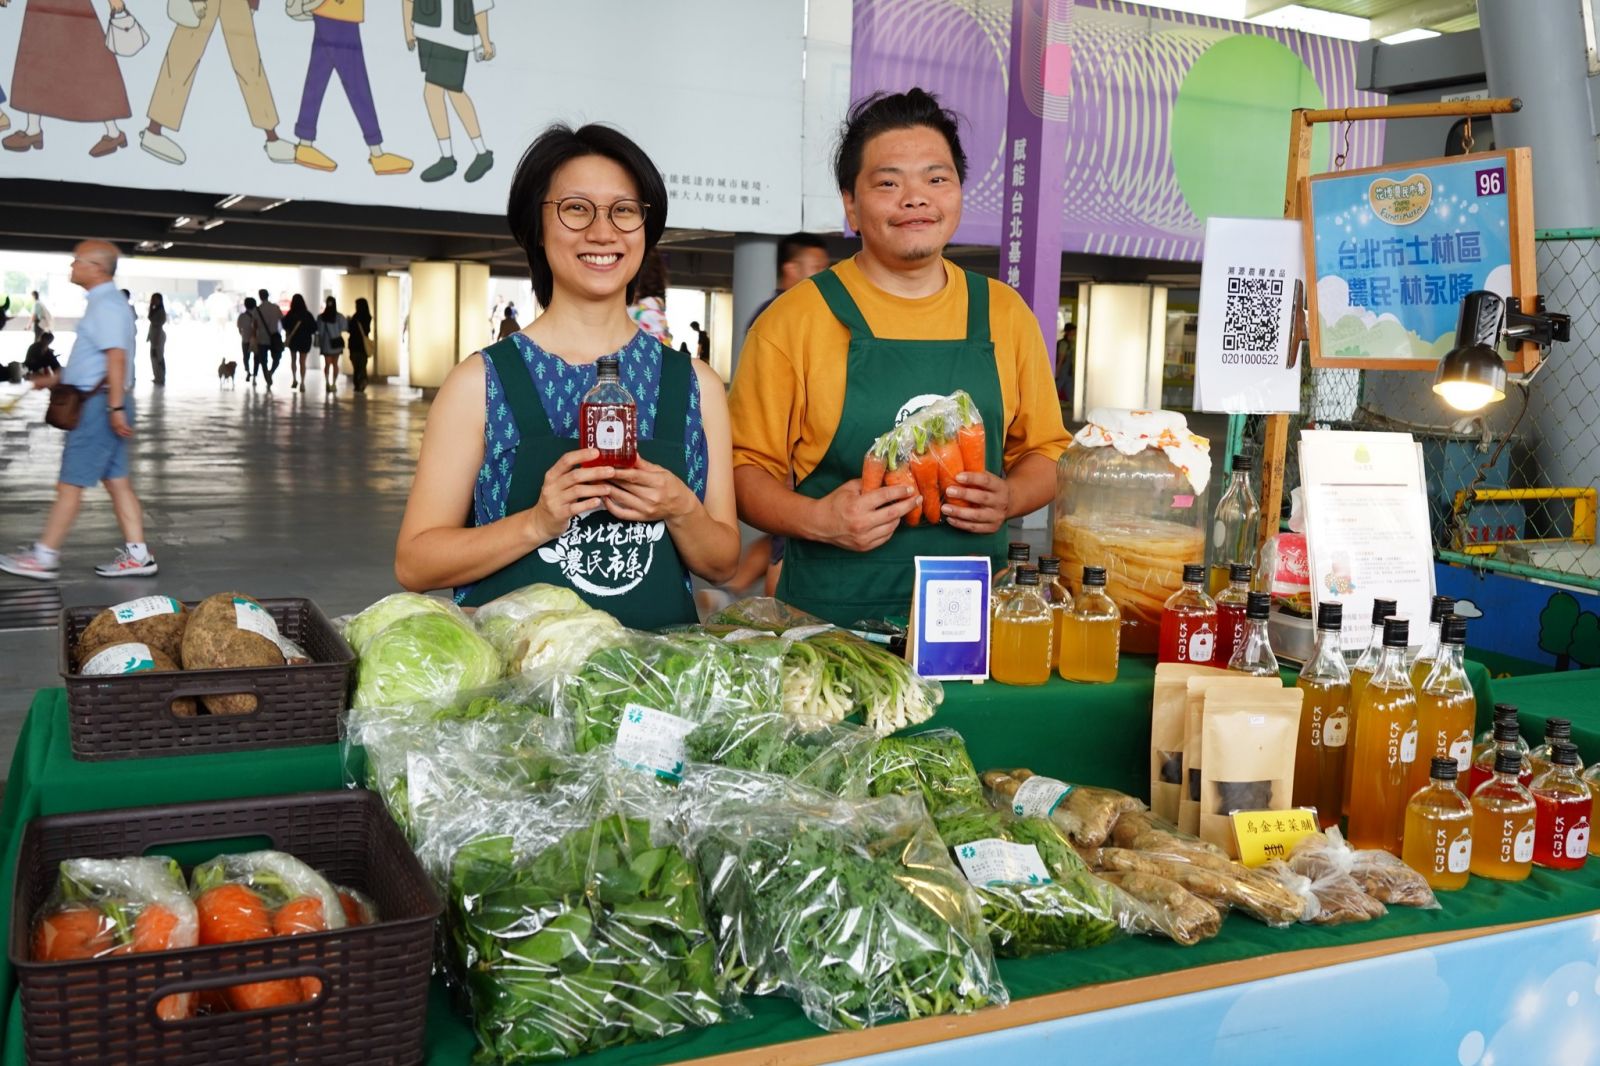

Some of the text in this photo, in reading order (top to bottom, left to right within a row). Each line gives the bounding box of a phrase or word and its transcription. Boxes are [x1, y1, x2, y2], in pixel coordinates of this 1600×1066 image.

[1480, 173, 1501, 195] 96
[1007, 137, 1027, 289] 賦能台北基地
[1338, 231, 1482, 270] 台北市士林區
[1221, 353, 1279, 365] 0201000522
[561, 516, 646, 546] 臺北花博
[562, 546, 644, 580] 農民市集
[1177, 622, 1188, 660] KUMBU
[1311, 706, 1322, 746] KUMBU
[1388, 722, 1400, 763] KUMBU
[1435, 829, 1447, 873] KUMBU
[1501, 820, 1513, 862] KUMBU
[1554, 816, 1565, 858] KUMBU
